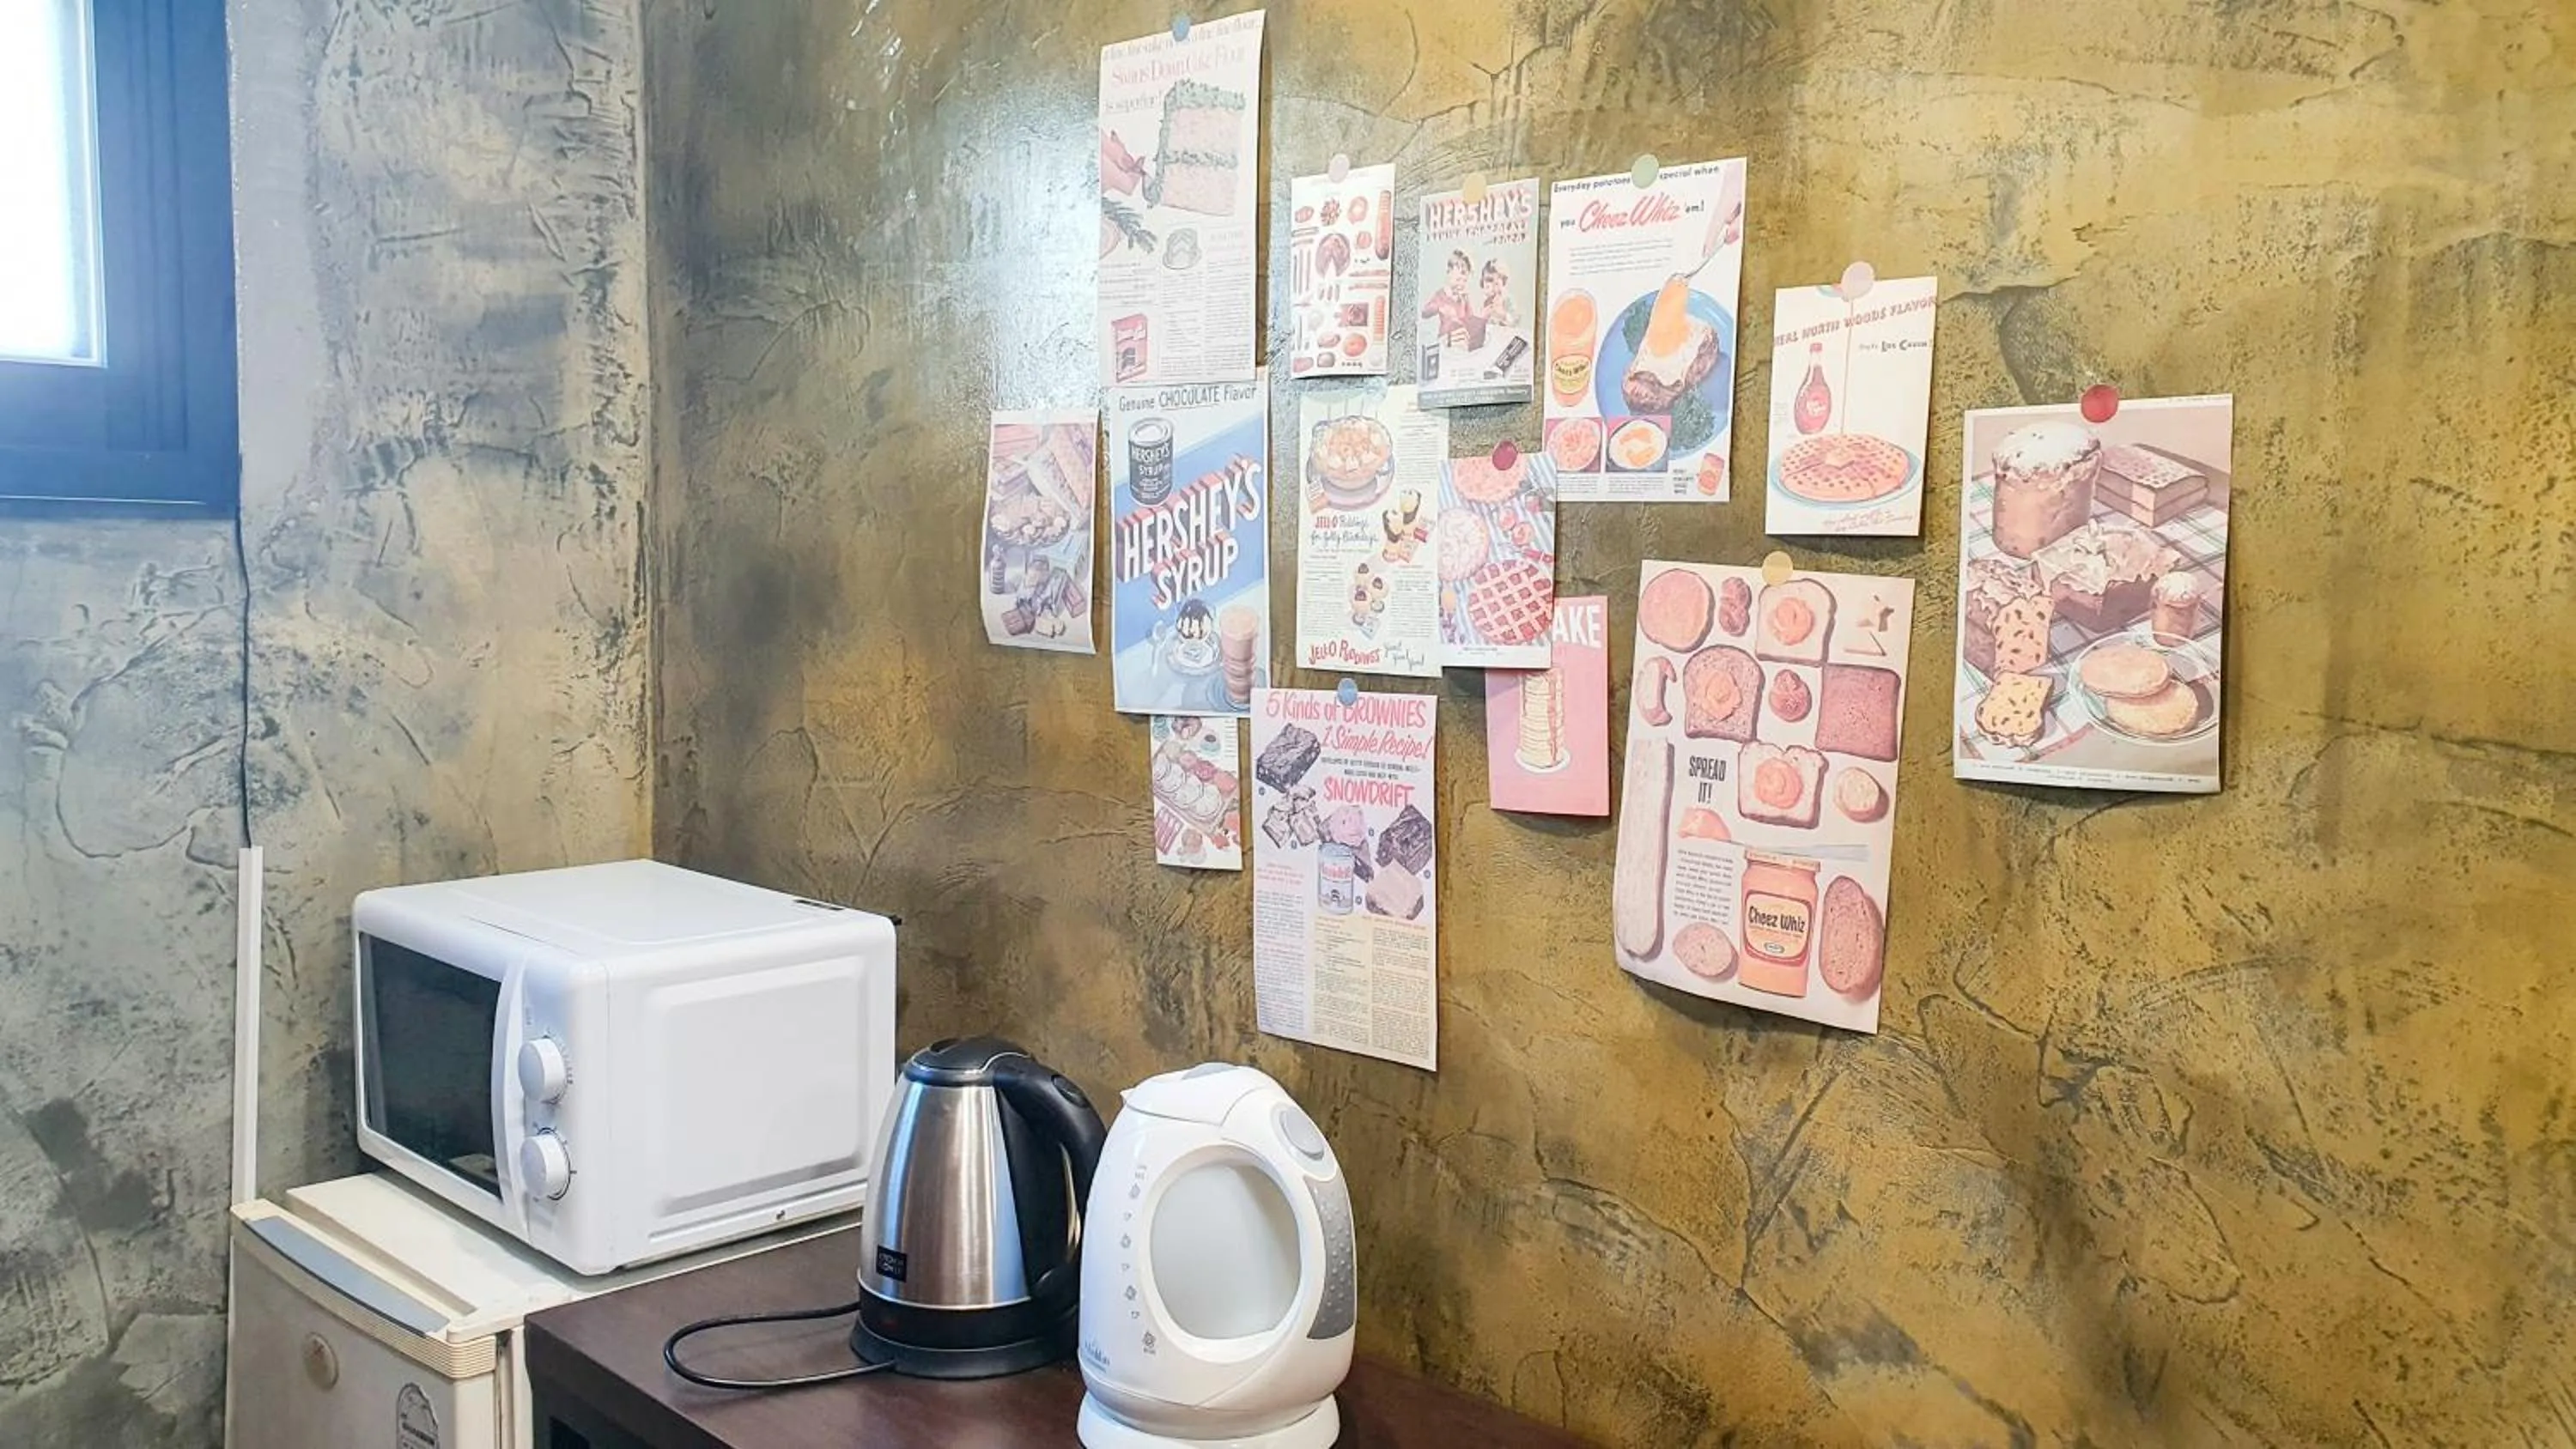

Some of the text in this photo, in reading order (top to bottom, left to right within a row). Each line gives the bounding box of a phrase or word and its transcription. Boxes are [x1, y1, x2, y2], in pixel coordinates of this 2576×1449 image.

[1578, 198, 1629, 233] Cheez
[1630, 191, 1681, 227] Whiz
[1157, 385, 1220, 408] CHOCOLATE
[1224, 384, 1258, 402] Flavor
[1121, 458, 1262, 584] HERSHEY'S
[1153, 534, 1240, 611] SYRUP
[1552, 604, 1602, 648] AKE
[1266, 691, 1281, 718] 5
[1283, 692, 1321, 722] Kinds
[1323, 695, 1340, 721] of
[1331, 724, 1379, 756] Simple
[1376, 730, 1433, 762] Recipe!
[1689, 755, 1727, 782] SPREAD
[1322, 775, 1416, 808] SNOWDRIFT
[1698, 782, 1713, 804] IT!
[1748, 905, 1778, 928] Cheez
[1780, 912, 1806, 933] Whiz
